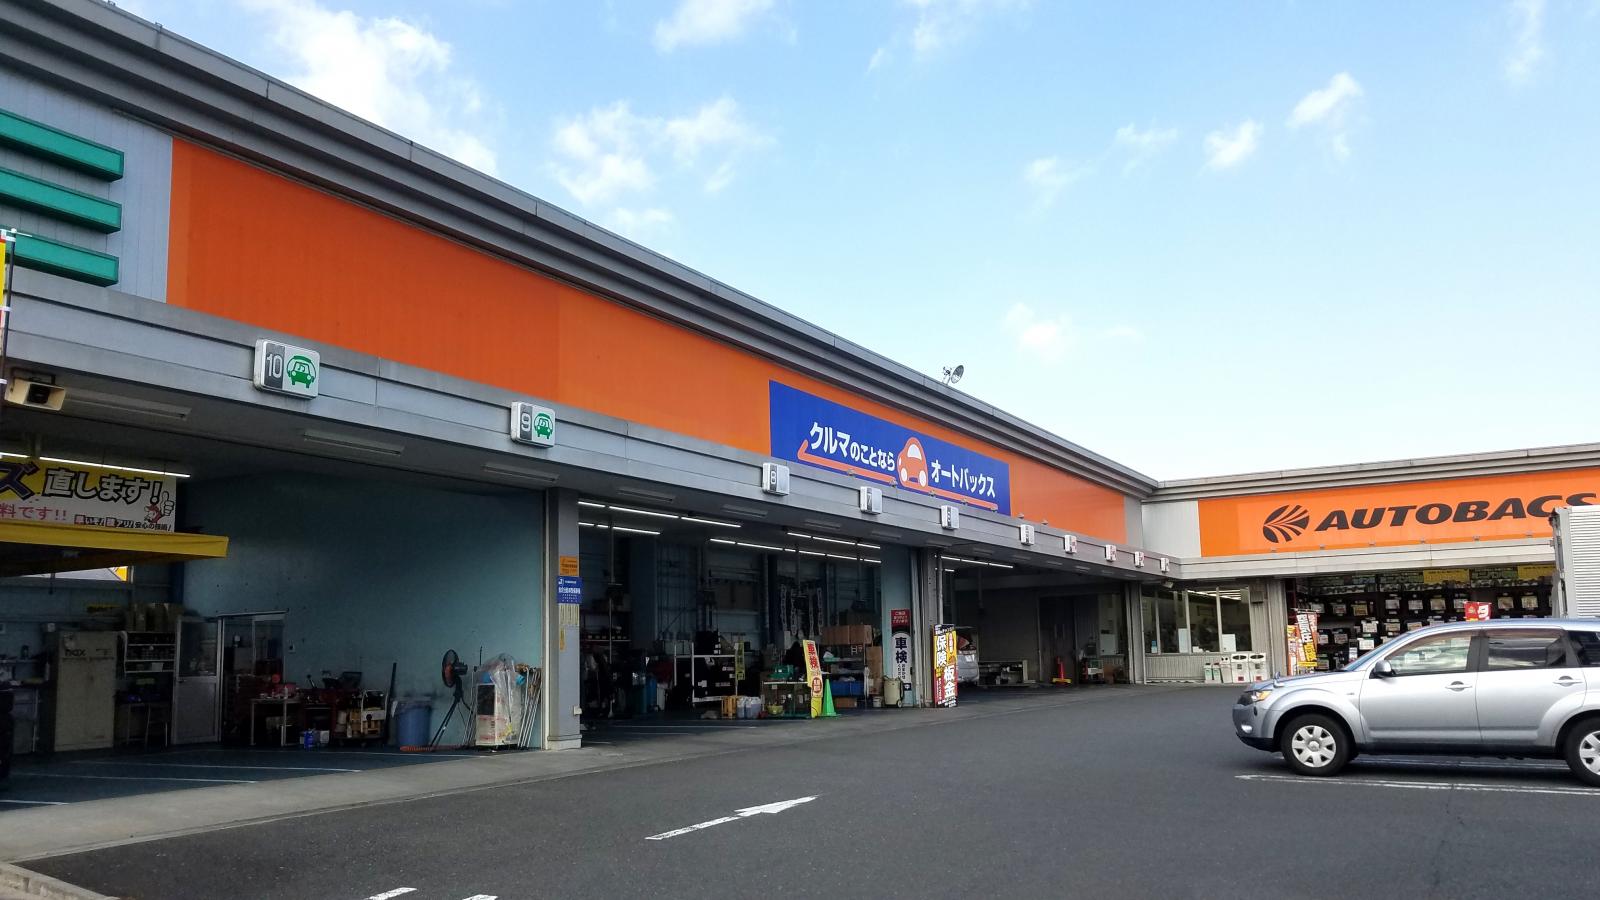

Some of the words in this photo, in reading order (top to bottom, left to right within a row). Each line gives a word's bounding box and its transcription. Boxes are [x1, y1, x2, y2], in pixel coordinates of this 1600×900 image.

[266, 352, 284, 379] 10
[520, 411, 532, 432] 9
[809, 421, 896, 472] クルマのことなら
[930, 458, 996, 498] オートバックス
[895, 636, 908, 664] 車検
[936, 635, 948, 668] 保険
[943, 664, 957, 699] 板金
